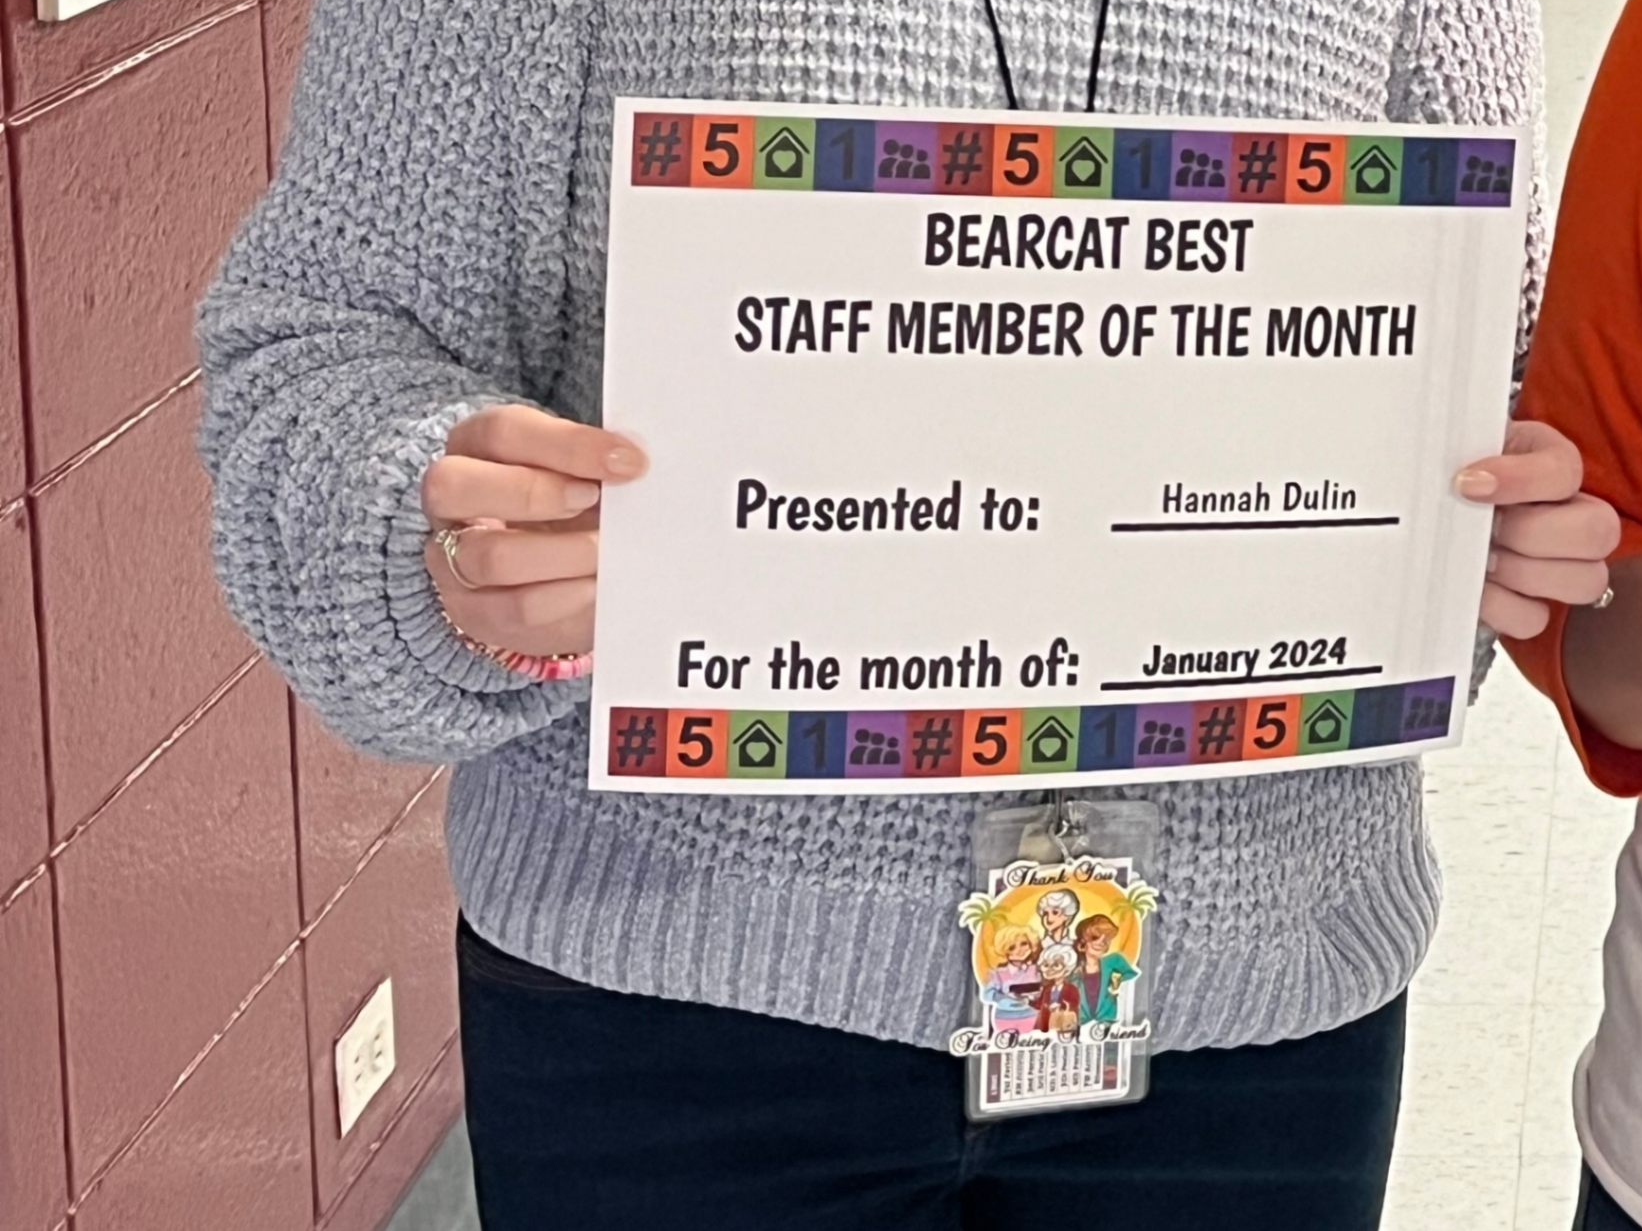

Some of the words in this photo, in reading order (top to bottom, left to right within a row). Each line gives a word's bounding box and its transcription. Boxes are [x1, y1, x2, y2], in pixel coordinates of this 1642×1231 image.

[926, 213, 1129, 270] BEARCAT
[1146, 219, 1253, 272] BEST
[736, 297, 872, 353] STAFF
[889, 302, 1083, 356] MEMBER
[1101, 304, 1156, 356] OF
[1171, 304, 1250, 356] THE
[1267, 305, 1415, 357] MONTH
[737, 479, 960, 531] Presented
[981, 489, 1038, 530] to:
[1163, 482, 1270, 513] Hannah
[1283, 480, 1356, 511] Dulin
[679, 641, 750, 689] For
[769, 641, 839, 690] the
[861, 640, 1001, 689] month
[1021, 638, 1078, 687] of:
[1143, 645, 1260, 678] January
[1269, 638, 1347, 668] 2024
[1007, 864, 1069, 888] Thank
[1073, 860, 1114, 883] You
[994, 1028, 1051, 1051] Being
[1089, 1022, 1147, 1042] Friend
